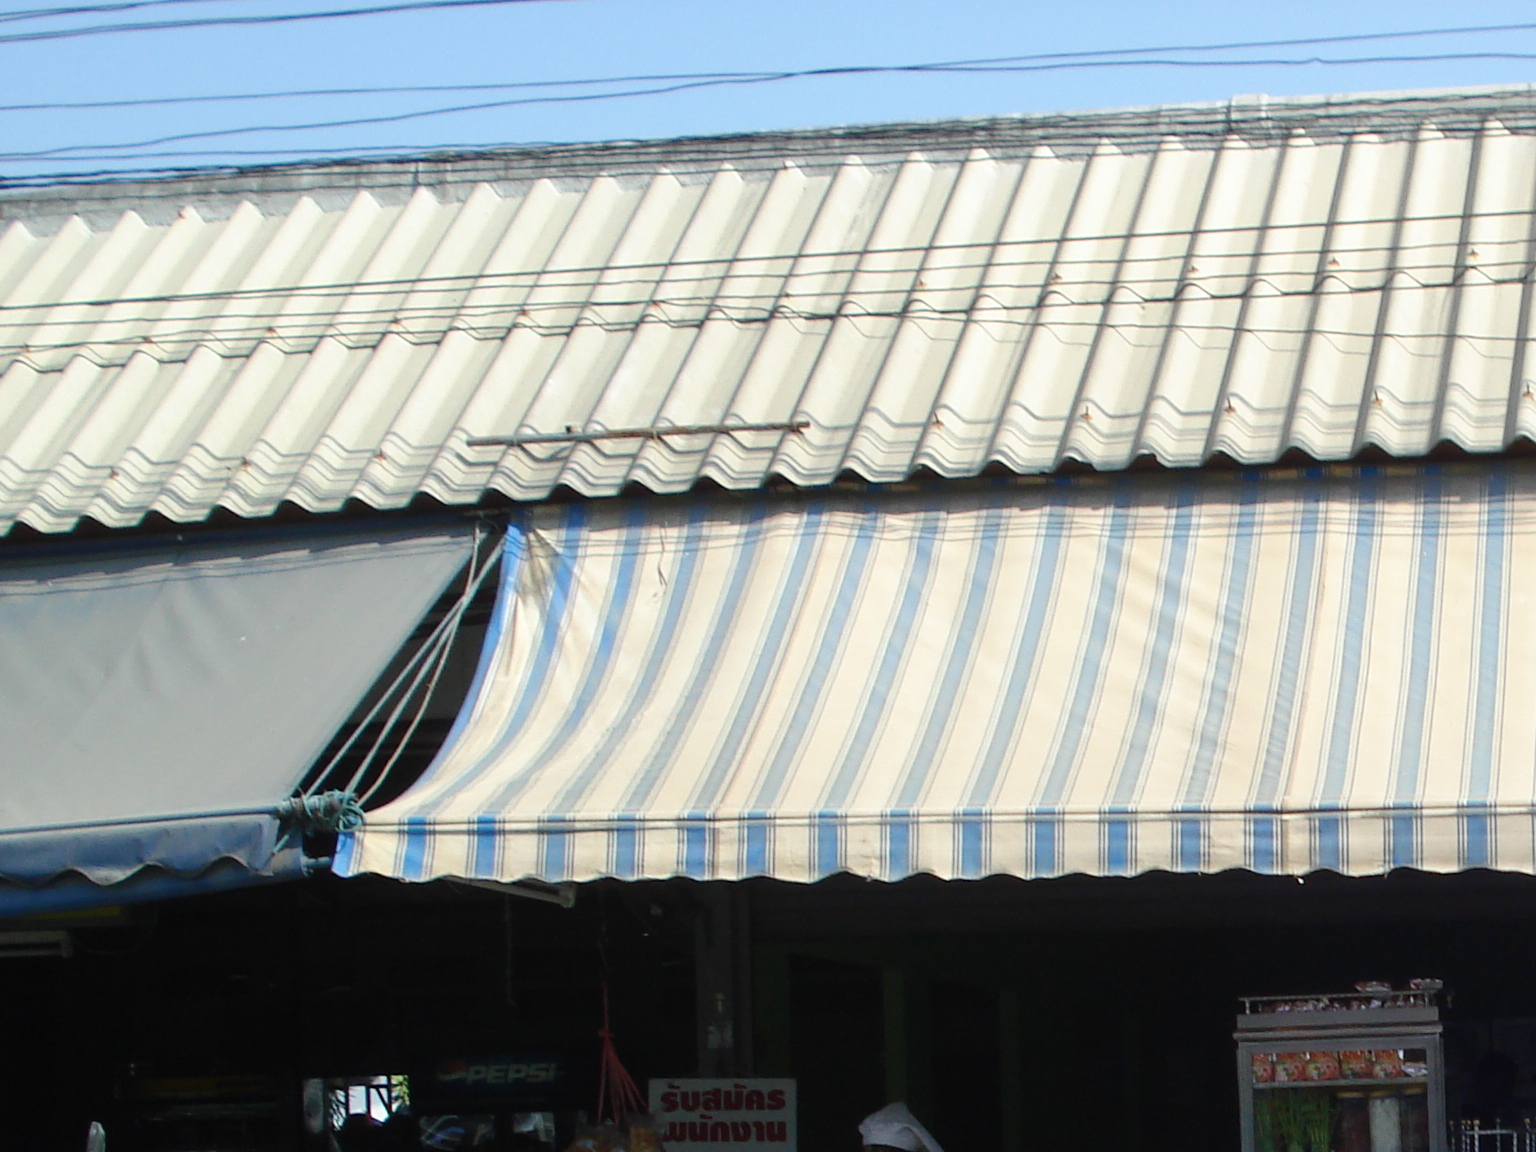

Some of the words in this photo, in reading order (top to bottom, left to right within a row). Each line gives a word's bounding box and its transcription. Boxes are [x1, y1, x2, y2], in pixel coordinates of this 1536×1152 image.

[464, 1062, 557, 1084] PEPSI
[660, 1082, 787, 1113] รับสมัคร
[661, 1114, 787, 1142] พนักงาน
